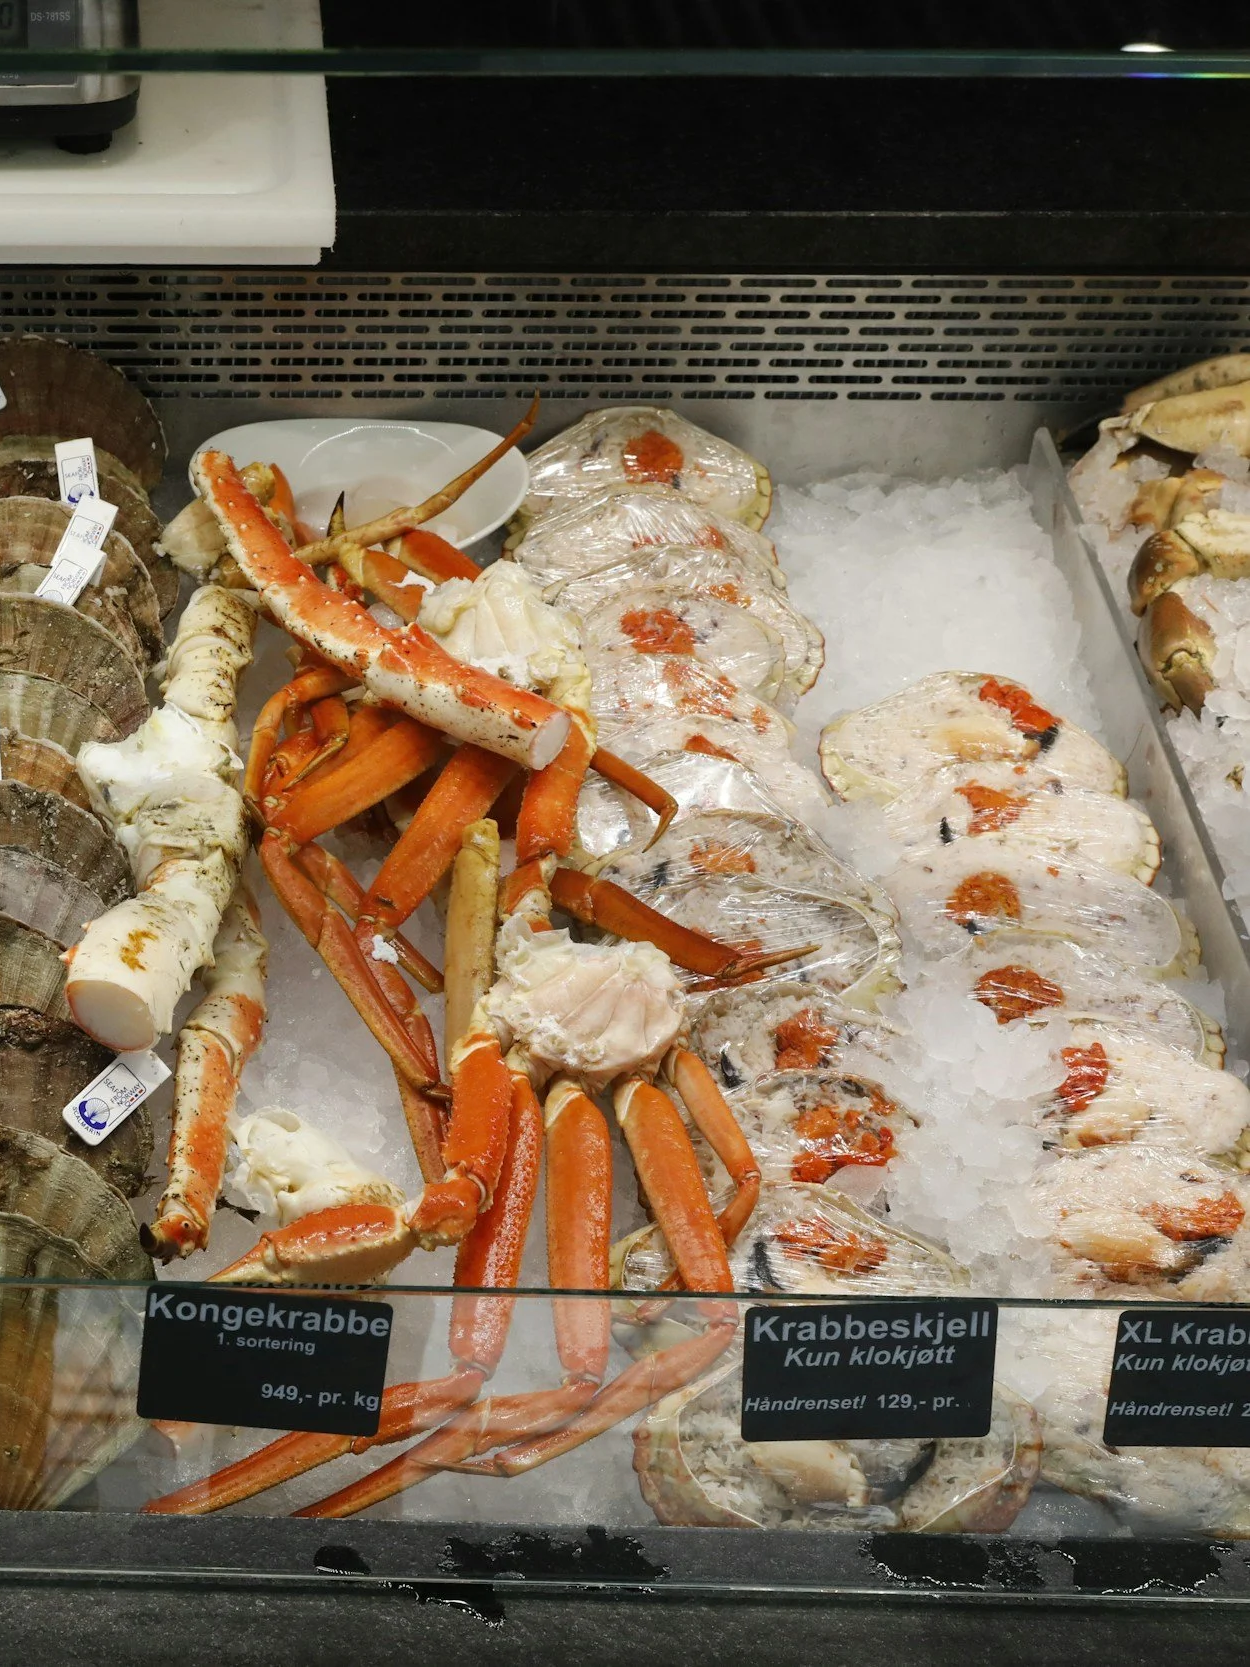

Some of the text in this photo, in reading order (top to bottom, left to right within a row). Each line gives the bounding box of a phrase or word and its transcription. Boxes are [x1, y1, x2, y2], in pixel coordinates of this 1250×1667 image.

[72, 1106, 101, 1136] SCALMARIN
[149, 1292, 390, 1337] Kongekrabbe
[753, 1312, 990, 1344] Krabbeskjell
[1118, 1320, 1250, 1346] XL Krab
[216, 1332, 316, 1356] 1. sortering
[784, 1344, 956, 1370] Kun klokjøtt
[1114, 1354, 1164, 1371] Kun
[261, 1384, 380, 1412] 949,- pr. kg
[744, 1394, 960, 1412] Håndrenset! 129,- pr.
[1108, 1400, 1234, 1416] Håndrenset!
